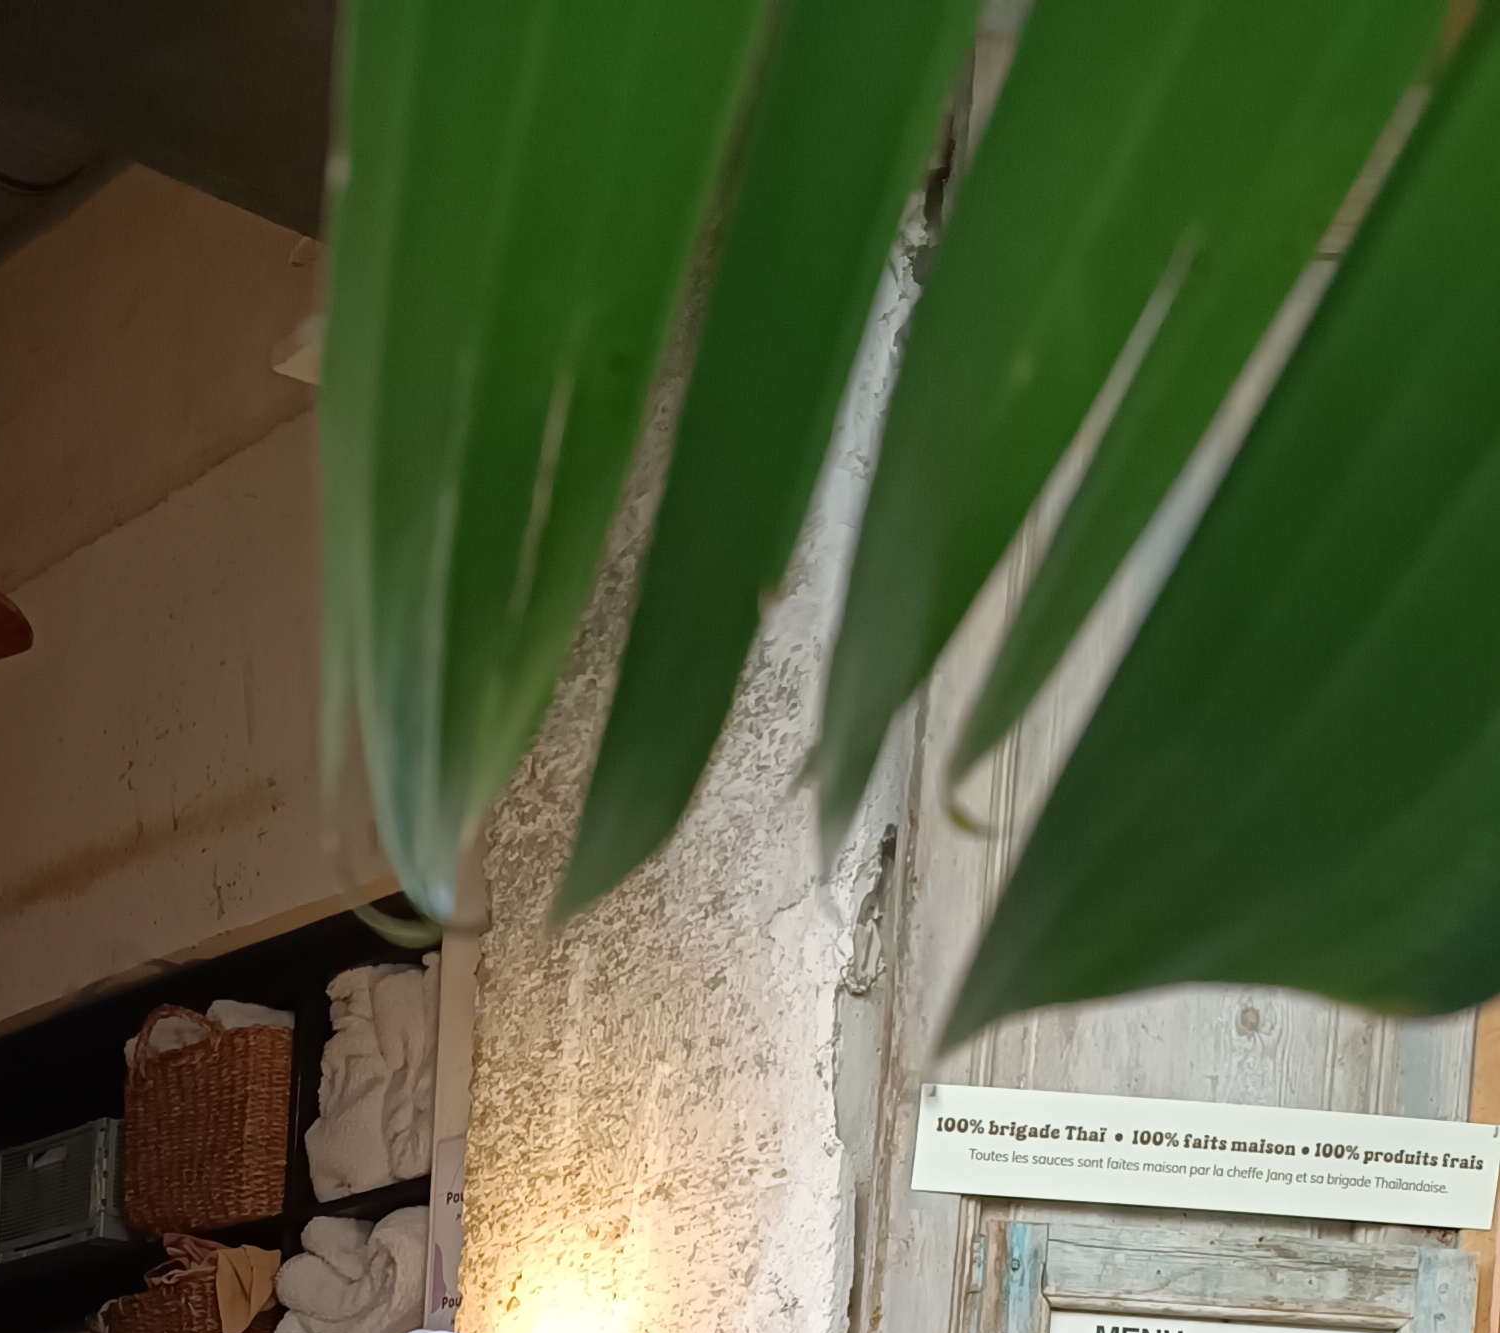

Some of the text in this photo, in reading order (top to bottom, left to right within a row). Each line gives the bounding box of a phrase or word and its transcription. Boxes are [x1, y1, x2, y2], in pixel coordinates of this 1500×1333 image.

[936, 1117, 1484, 1170] 100% brigade Thaï 100% faits maison 100% produits frais
[969, 1148, 1009, 1163] Toutes
[1012, 1151, 1029, 1164] les
[1032, 1155, 1074, 1168] sauces
[1077, 1156, 1104, 1169] sont
[1106, 1157, 1140, 1171] faites
[1142, 1160, 1187, 1175] maison
[1189, 1166, 1211, 1178] par
[1213, 1164, 1224, 1177] la
[1227, 1166, 1263, 1180] cheffe
[1265, 1167, 1293, 1184] Jang
[1296, 1172, 1307, 1183] et
[1310, 1174, 1324, 1184] sa
[1327, 1173, 1371, 1189] brigade
